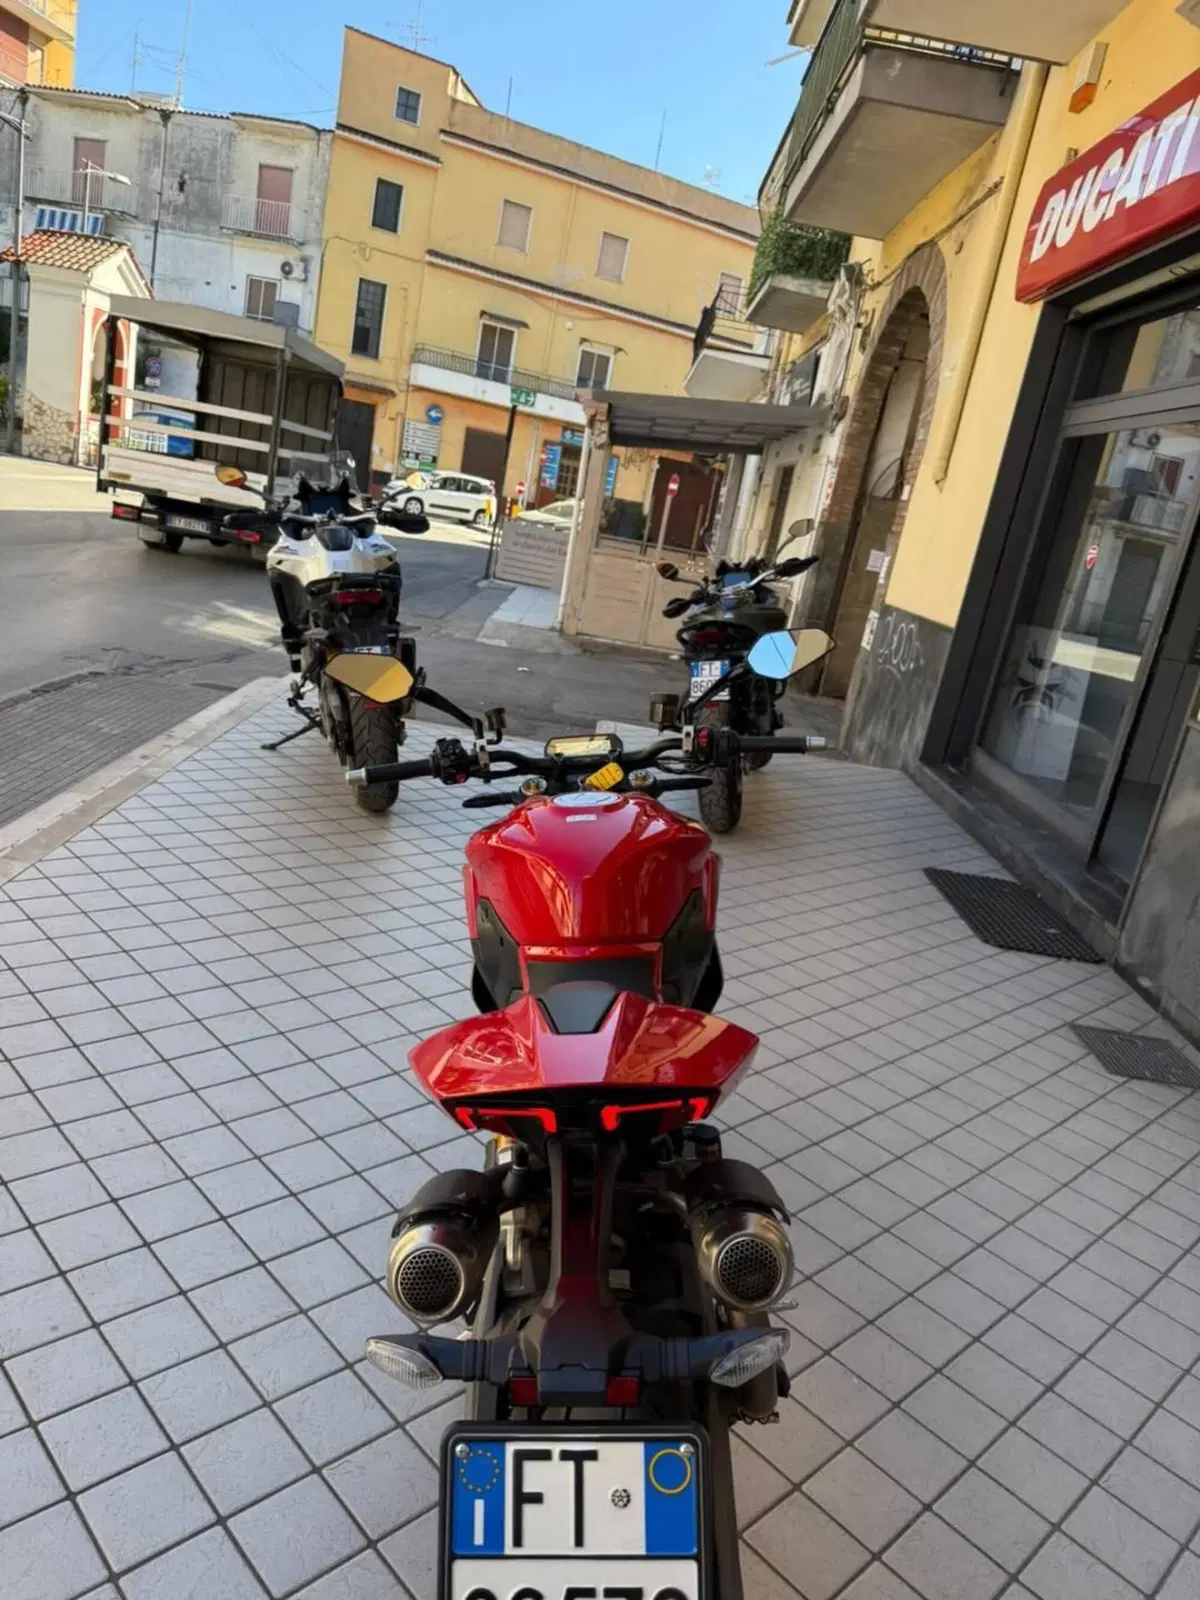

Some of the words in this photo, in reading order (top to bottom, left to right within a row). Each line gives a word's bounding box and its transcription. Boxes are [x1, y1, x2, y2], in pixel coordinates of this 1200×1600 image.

[1029, 96, 1200, 264] DUCATI
[701, 662, 714, 676] FT
[473, 1498, 484, 1546] I
[512, 1449, 598, 1548] FT
